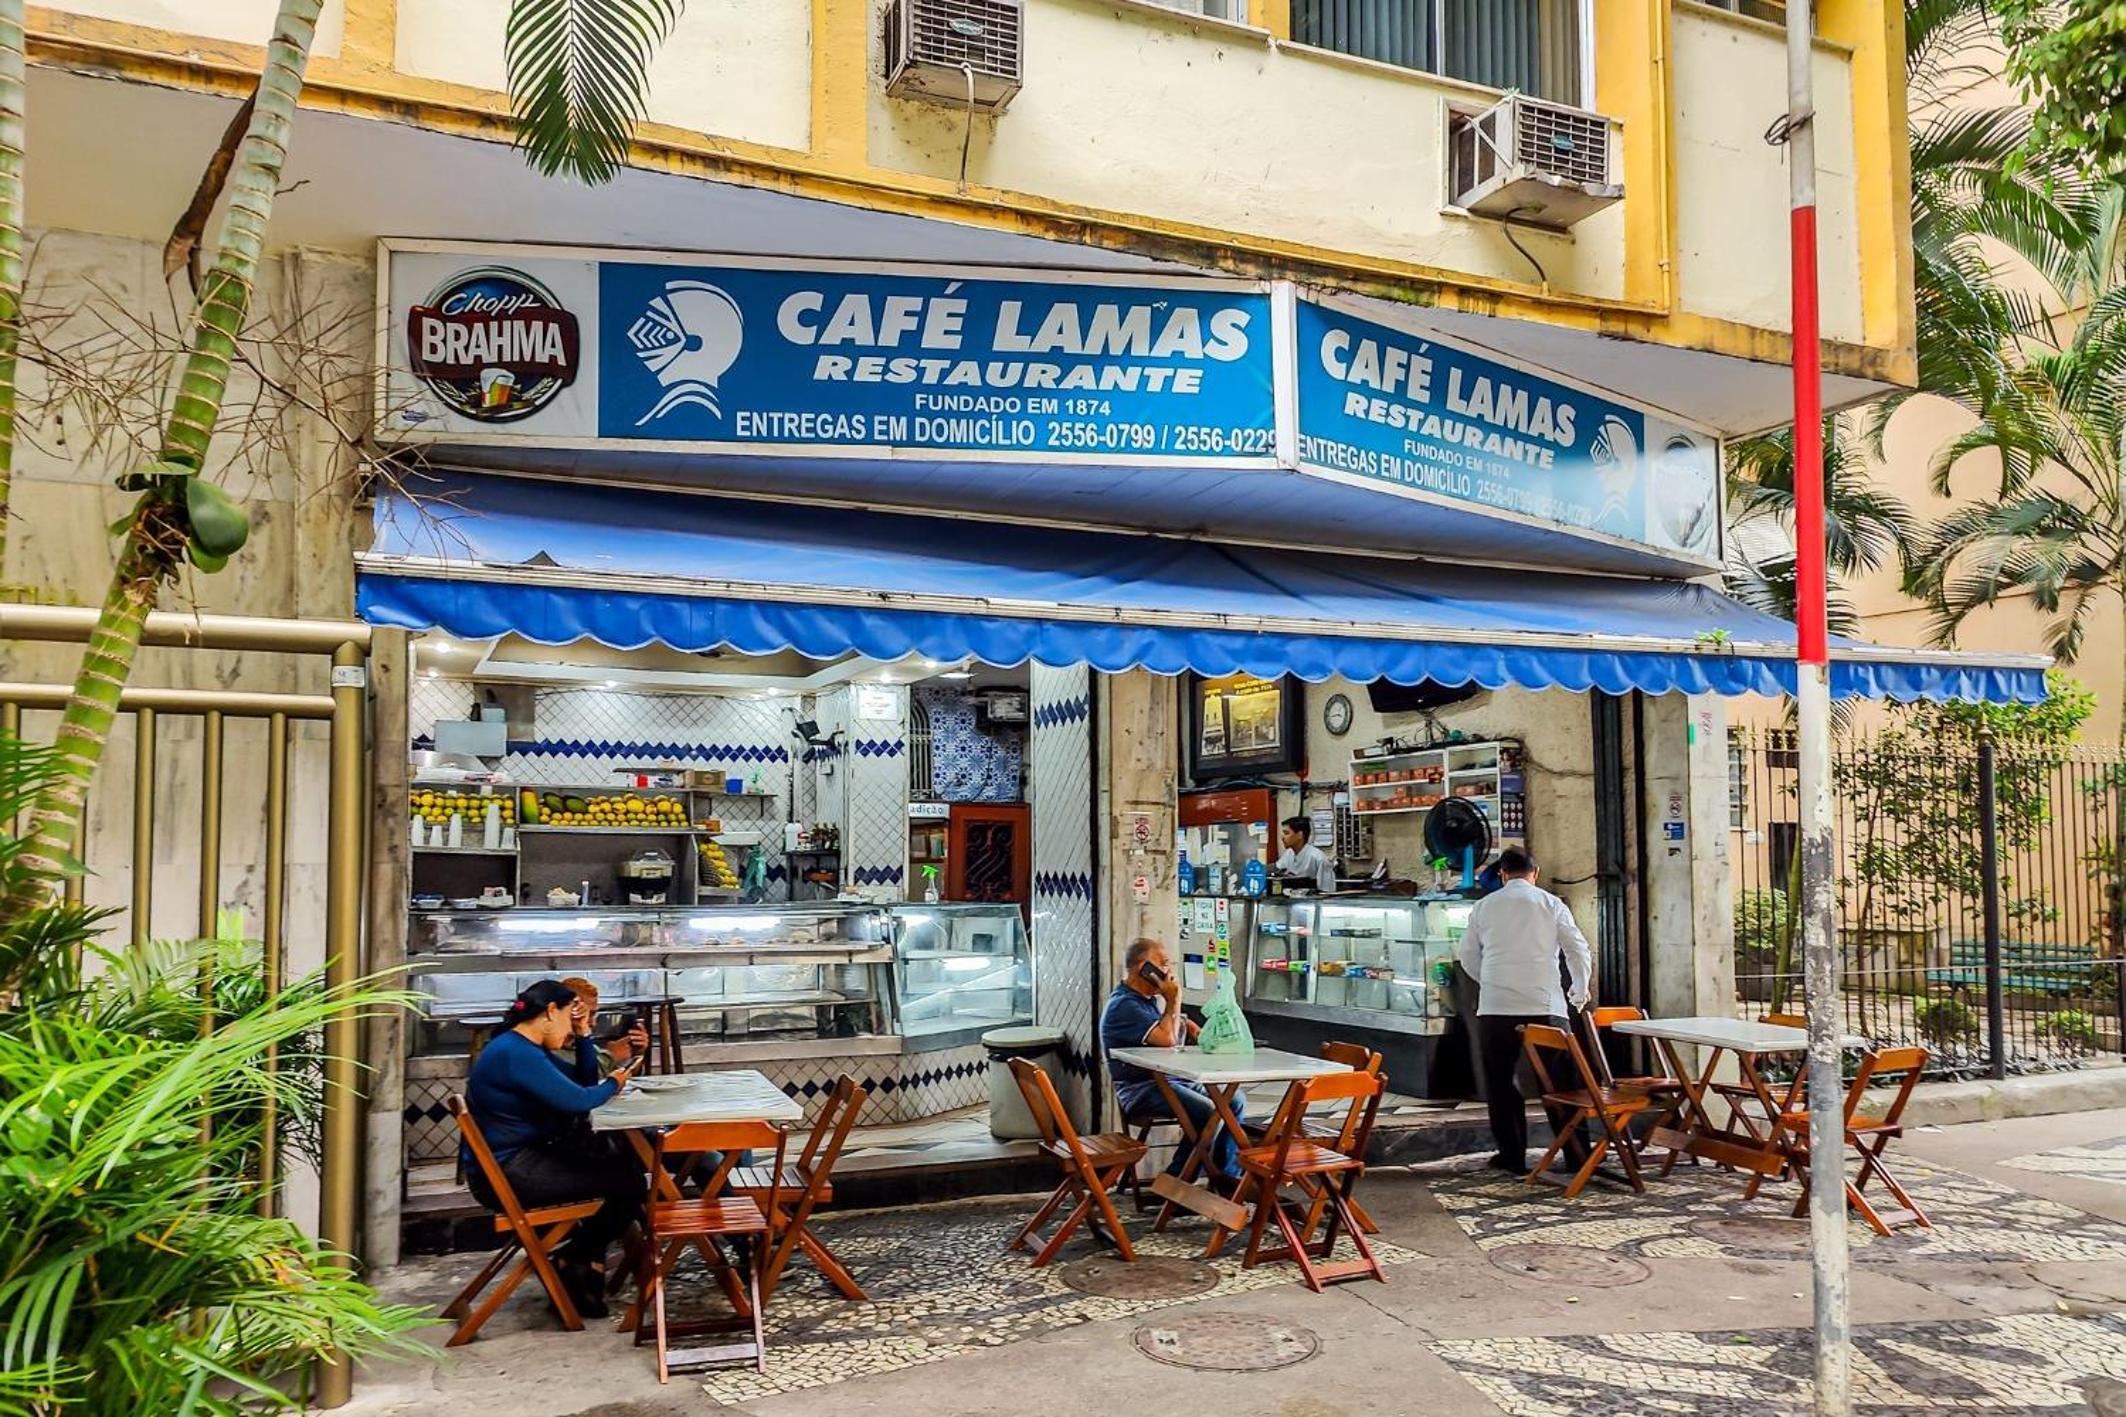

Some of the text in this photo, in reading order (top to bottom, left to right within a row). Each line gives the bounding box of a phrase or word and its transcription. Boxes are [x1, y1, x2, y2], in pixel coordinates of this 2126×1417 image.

[442, 291, 541, 317] Chopp
[777, 282, 1251, 362] CAFÉ LAMAS
[422, 317, 566, 368] BRAHMA
[813, 355, 1203, 394] RESTAURANTE
[1320, 329, 1576, 447] CAFÉ LAMAS
[915, 393, 1112, 416] FUNDADO EM 1874
[736, 411, 867, 440] ENTREGAS
[873, 415, 908, 441] EM
[915, 414, 1036, 446] DOMICÍLIO
[1048, 420, 1156, 449] 2556-0799
[1174, 428, 1276, 453] 2556-0229
[1344, 391, 1554, 469] RESTAURANTE
[1299, 434, 1377, 475] ENTREGAS
[1380, 453, 1400, 480] EM
[1404, 459, 1471, 497] DOMICÍLIO
[1404, 438, 1463, 467] FUNDADO
[1465, 455, 1483, 472] EM
